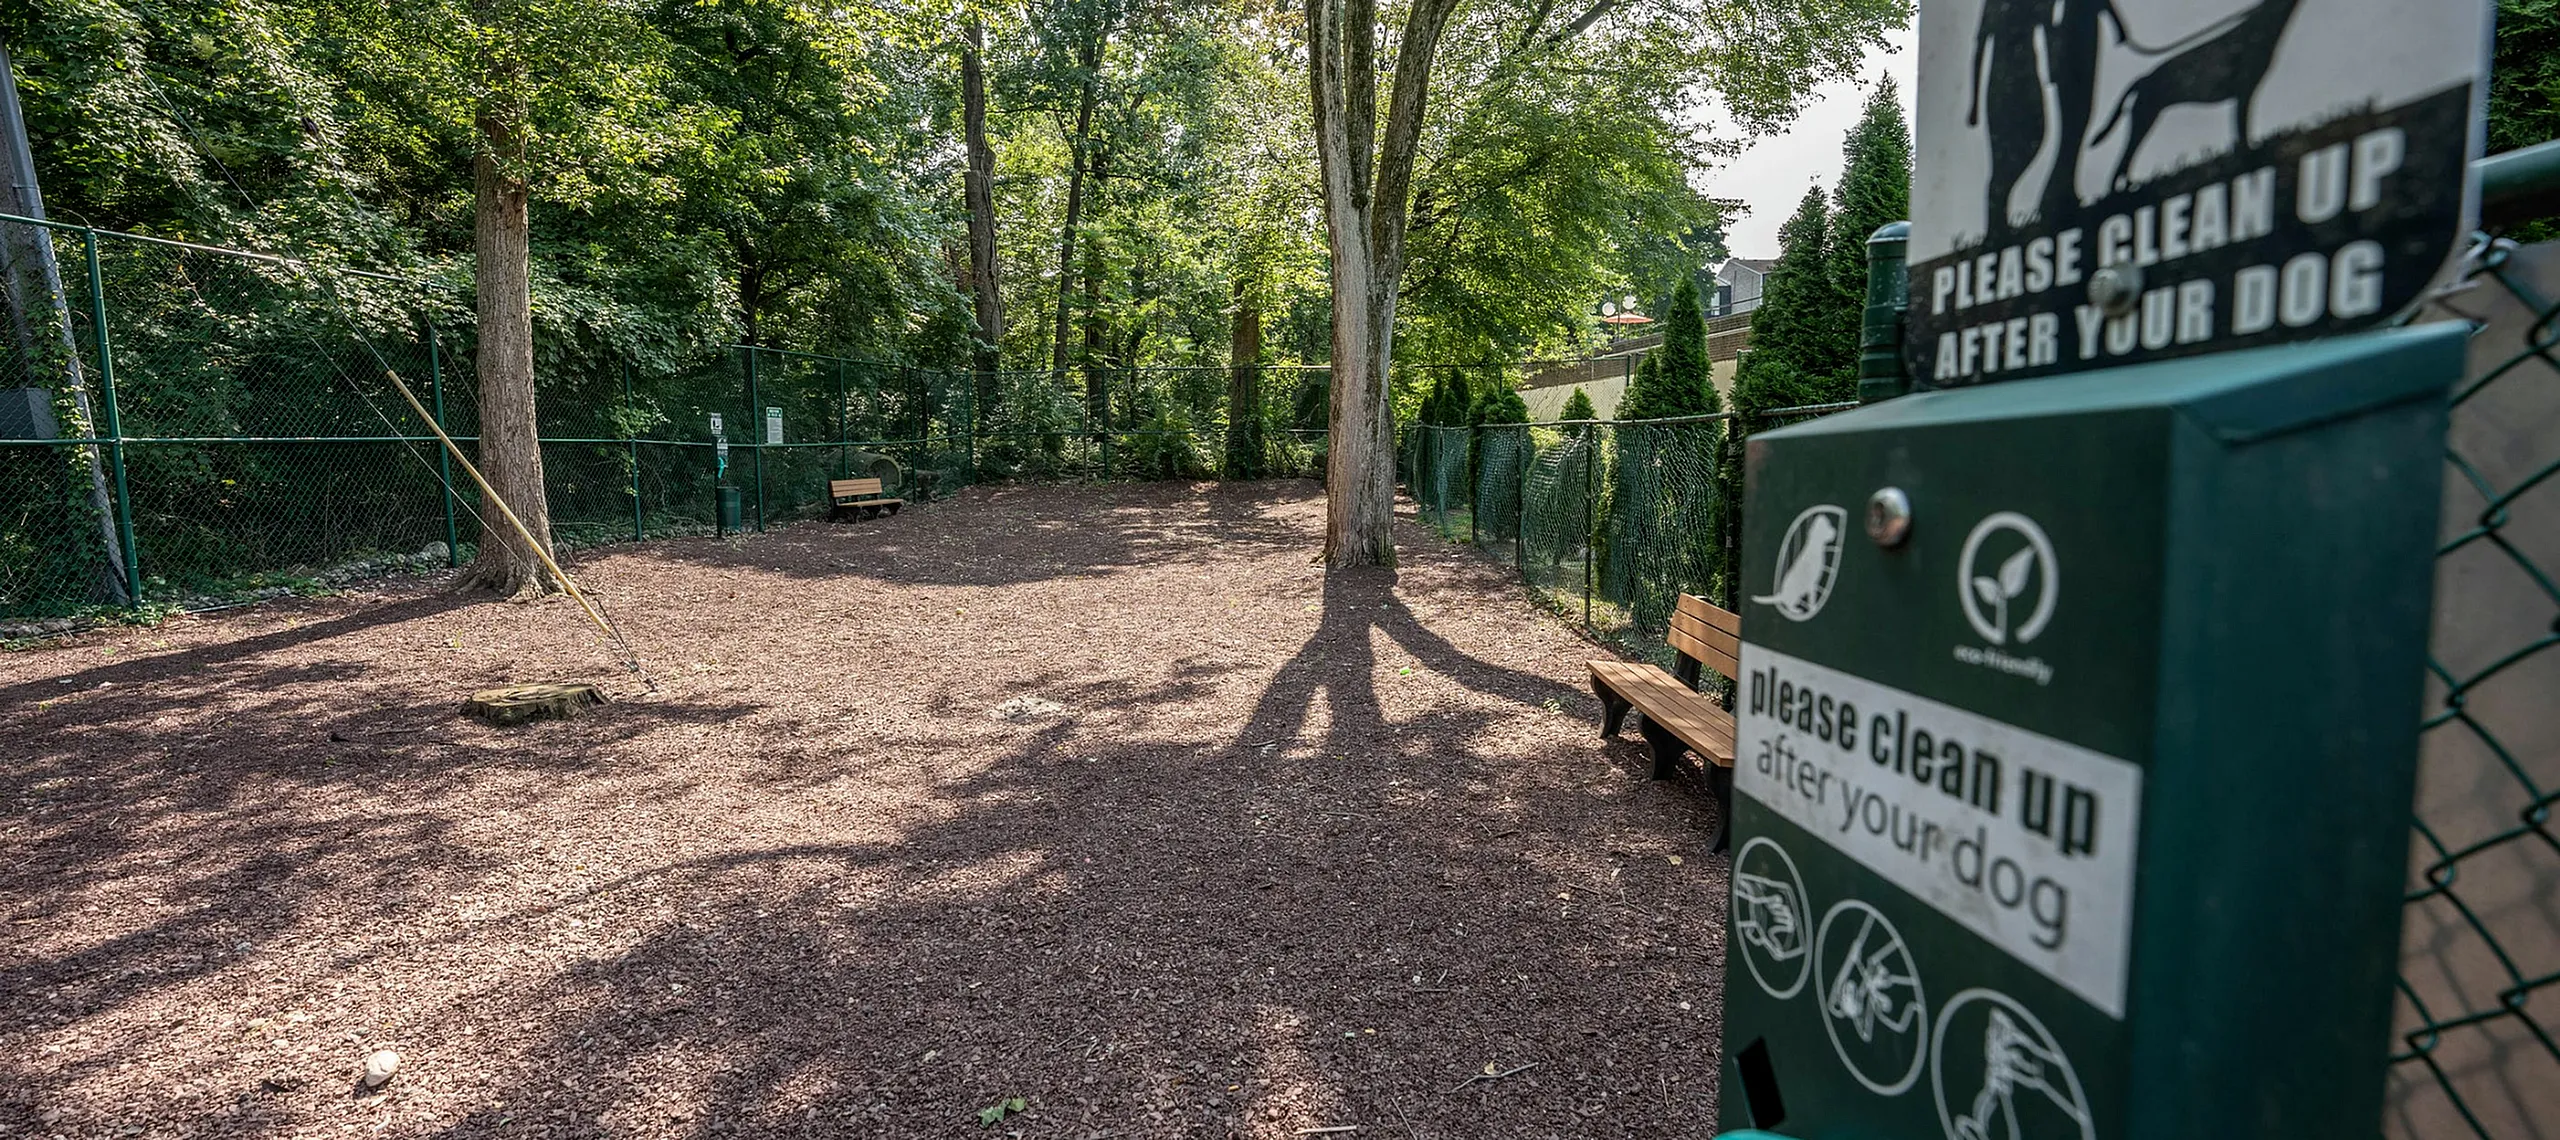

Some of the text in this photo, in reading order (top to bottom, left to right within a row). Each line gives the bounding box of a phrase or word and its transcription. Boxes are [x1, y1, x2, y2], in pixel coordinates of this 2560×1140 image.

[1932, 127, 2405, 314] PLEASE CLEAN UP
[1934, 240, 2384, 381] AFTER YOUR DOG
[1750, 667, 2099, 860] please clean up
[1756, 735, 2068, 953] after your dog
